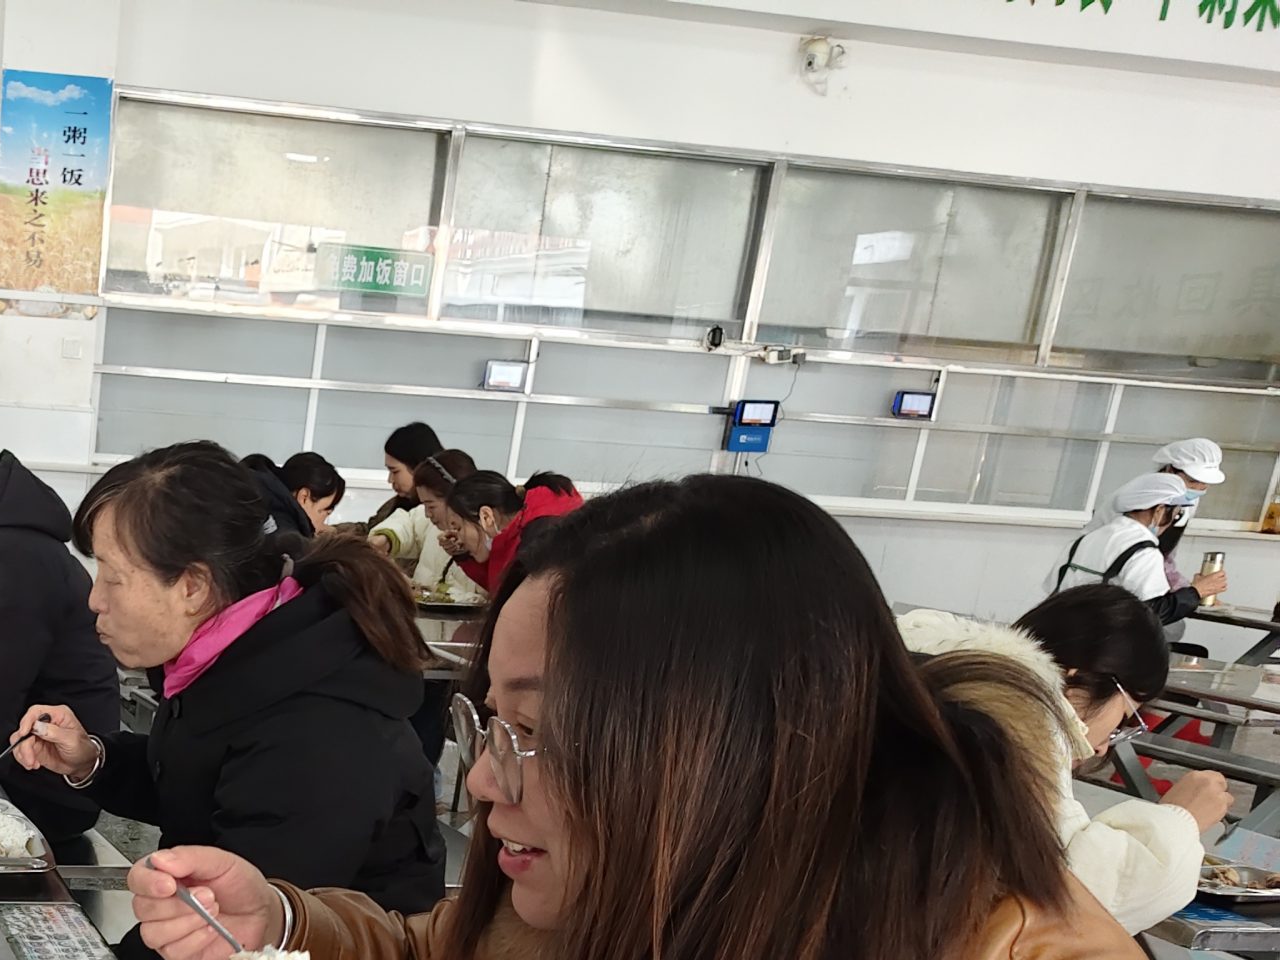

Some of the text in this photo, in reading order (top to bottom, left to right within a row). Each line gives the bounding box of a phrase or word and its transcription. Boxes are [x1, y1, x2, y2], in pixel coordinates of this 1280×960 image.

[61, 111, 88, 186] 一粥一饭
[24, 147, 50, 269] 当思来之不易
